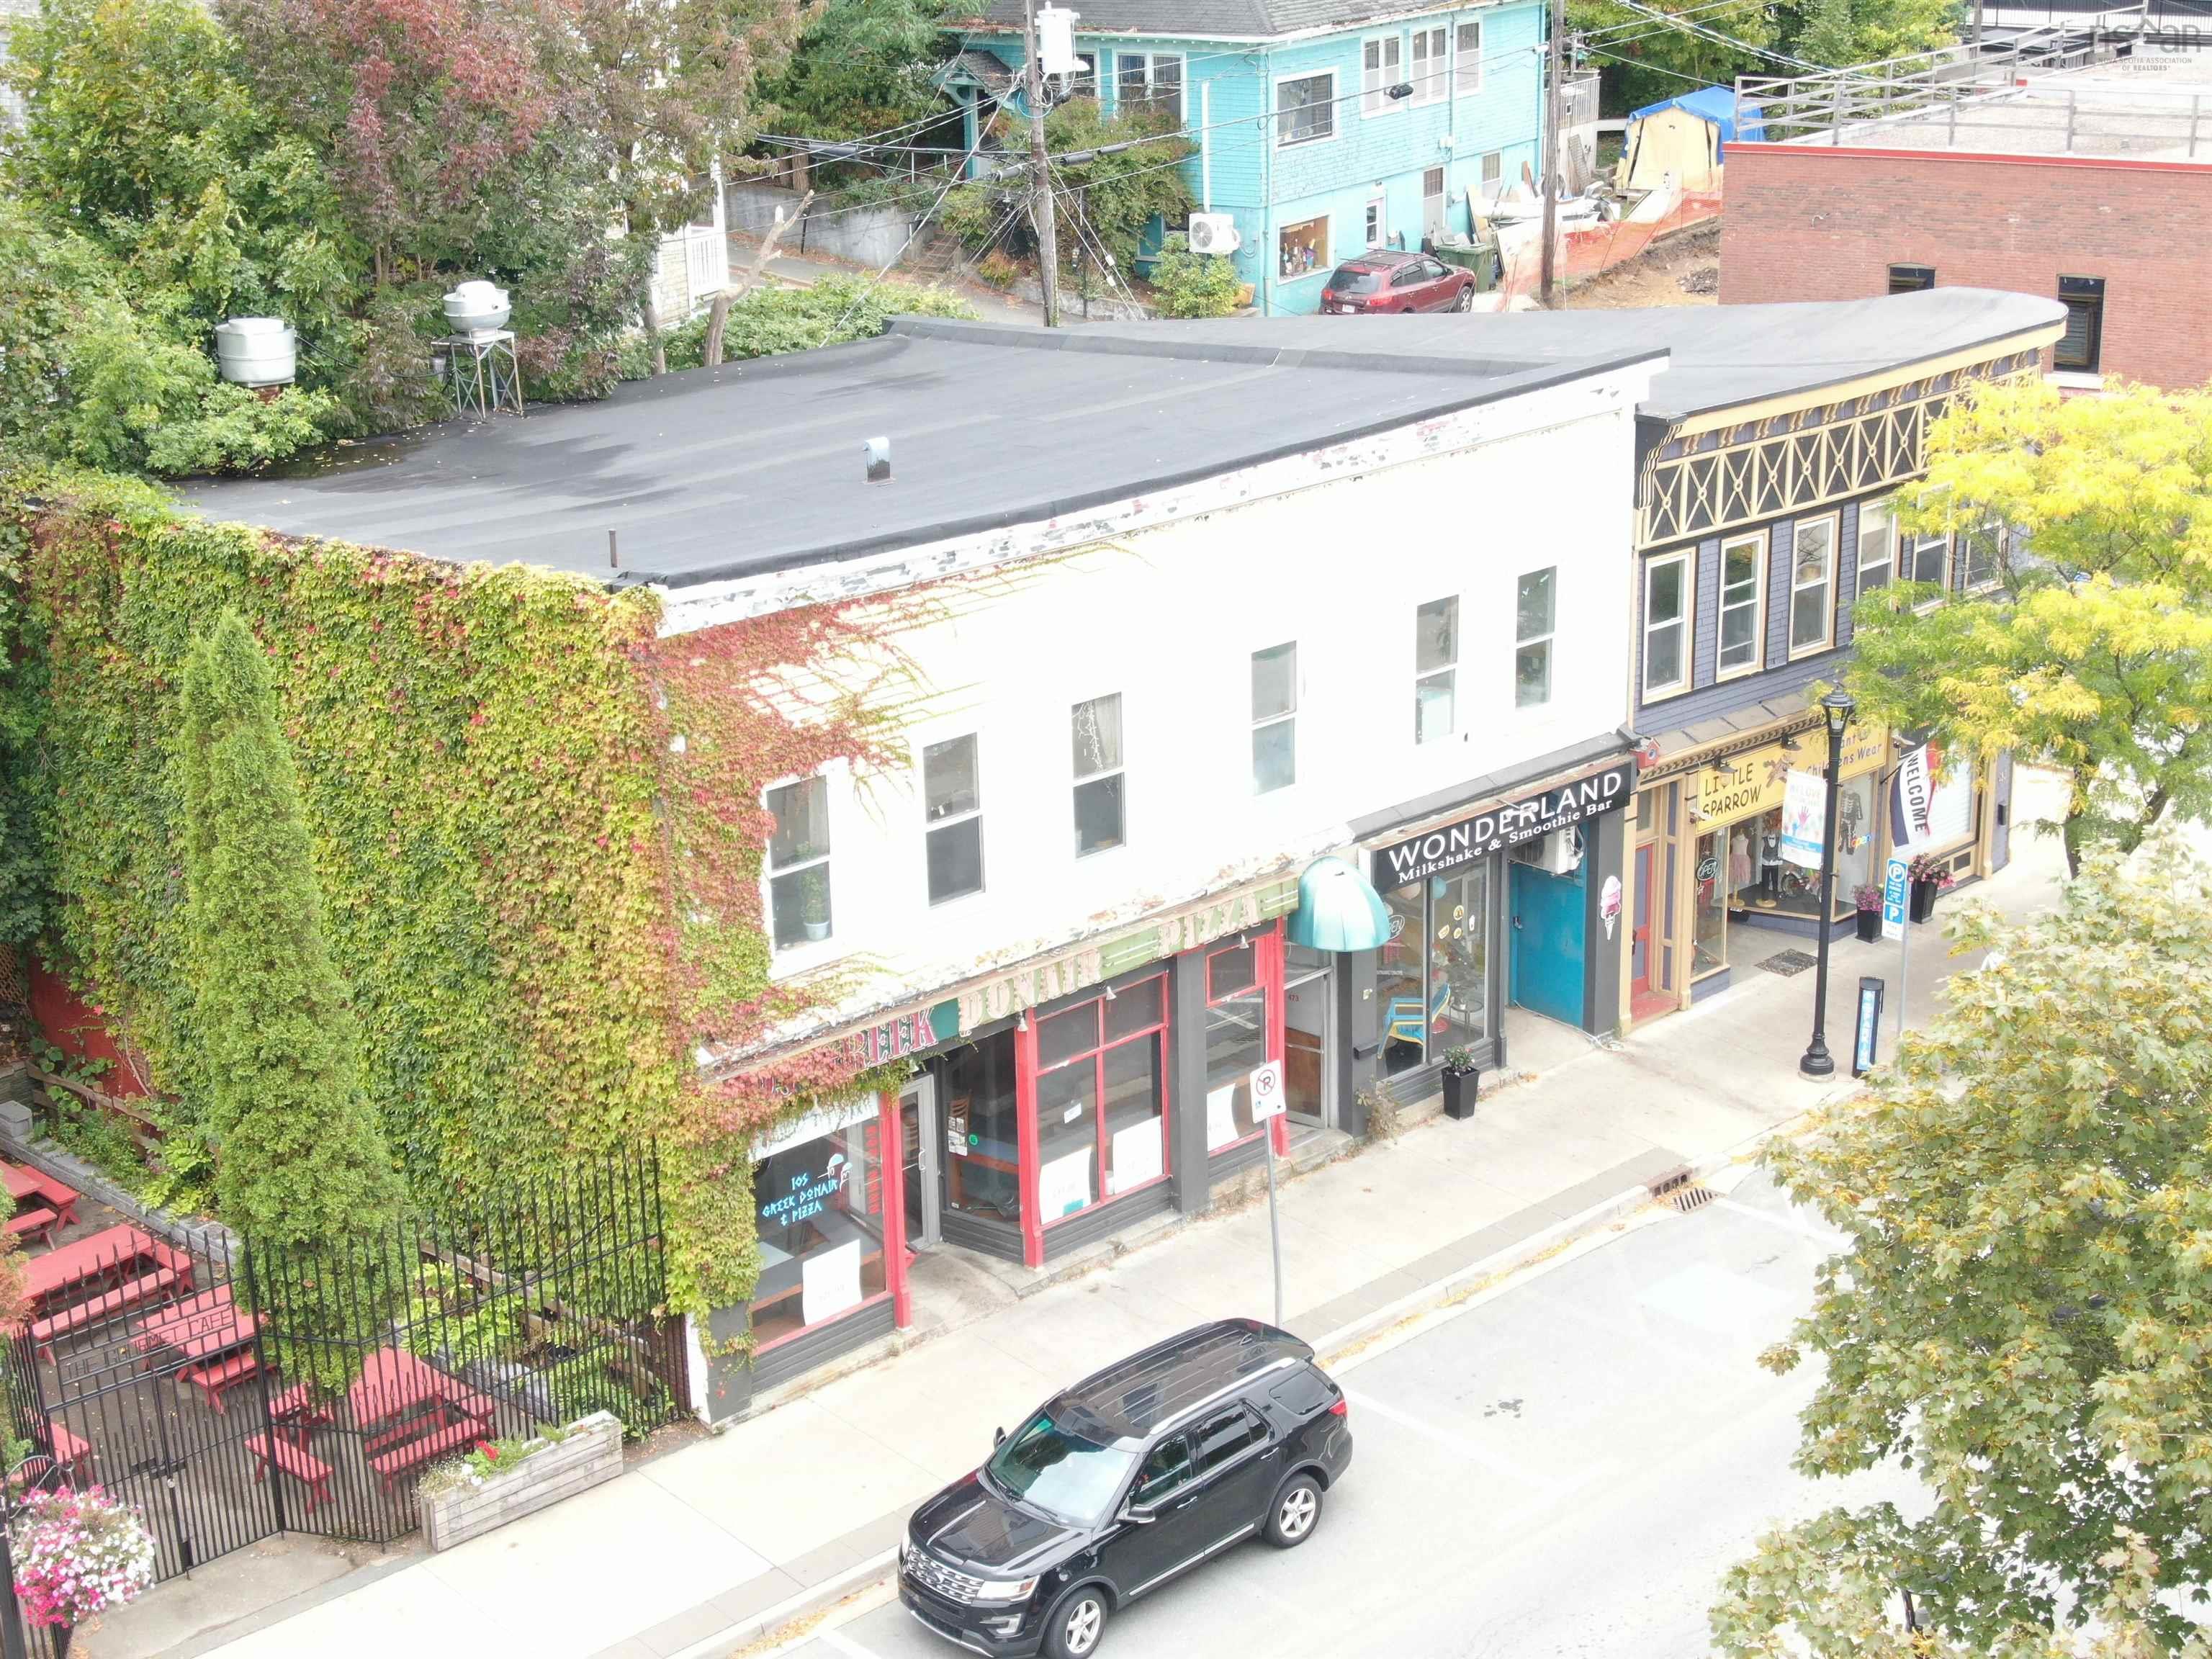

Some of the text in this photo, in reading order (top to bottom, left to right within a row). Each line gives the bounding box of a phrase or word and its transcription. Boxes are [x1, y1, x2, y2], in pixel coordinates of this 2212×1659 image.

[1857, 743, 1881, 760] Wear
[1704, 763, 1753, 797] LITLE
[1907, 752, 1927, 832] WELCOME
[1702, 783, 1762, 817] SPARROW
[1388, 772, 1622, 871] WONDERLAND
[1398, 799, 1613, 884] Milkshake & Smoothie Bar
[957, 946, 1103, 1038] DONAIR
[1156, 892, 1263, 959] PIZZA
[791, 1172, 809, 1191] IOS
[799, 1178, 839, 1205] DONAIR
[792, 1200, 822, 1223] PIZZA
